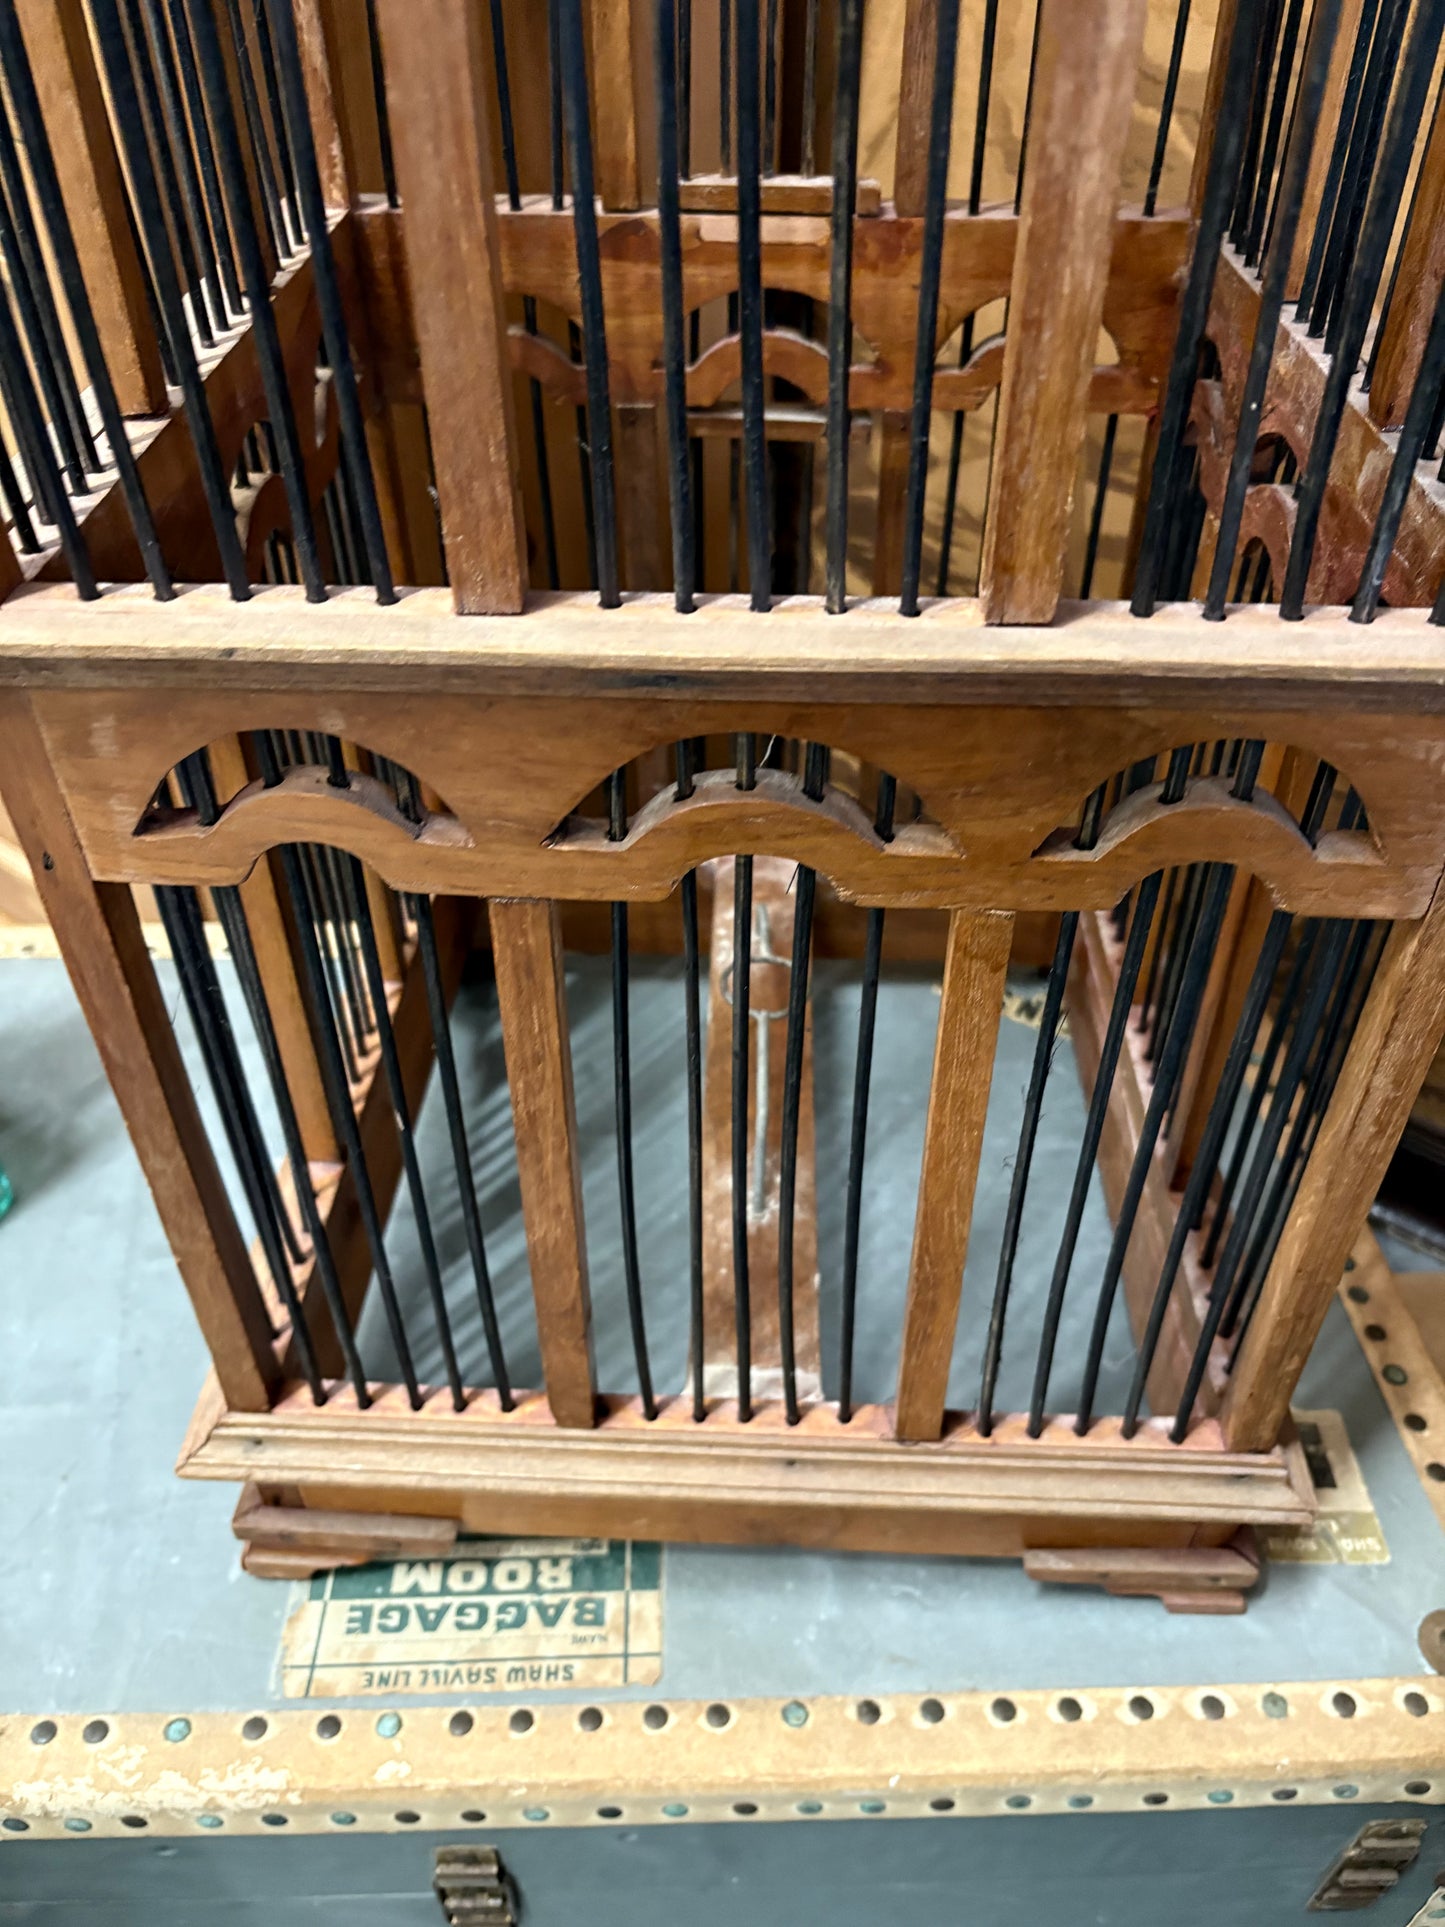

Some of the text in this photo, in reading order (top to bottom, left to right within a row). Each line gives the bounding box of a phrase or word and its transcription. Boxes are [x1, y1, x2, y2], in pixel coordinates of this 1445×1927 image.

[391, 1559, 573, 1593] ROOM
[346, 1597, 605, 1634] BAGGAGE
[363, 1664, 574, 1688] SHAW SAVILL LINE
